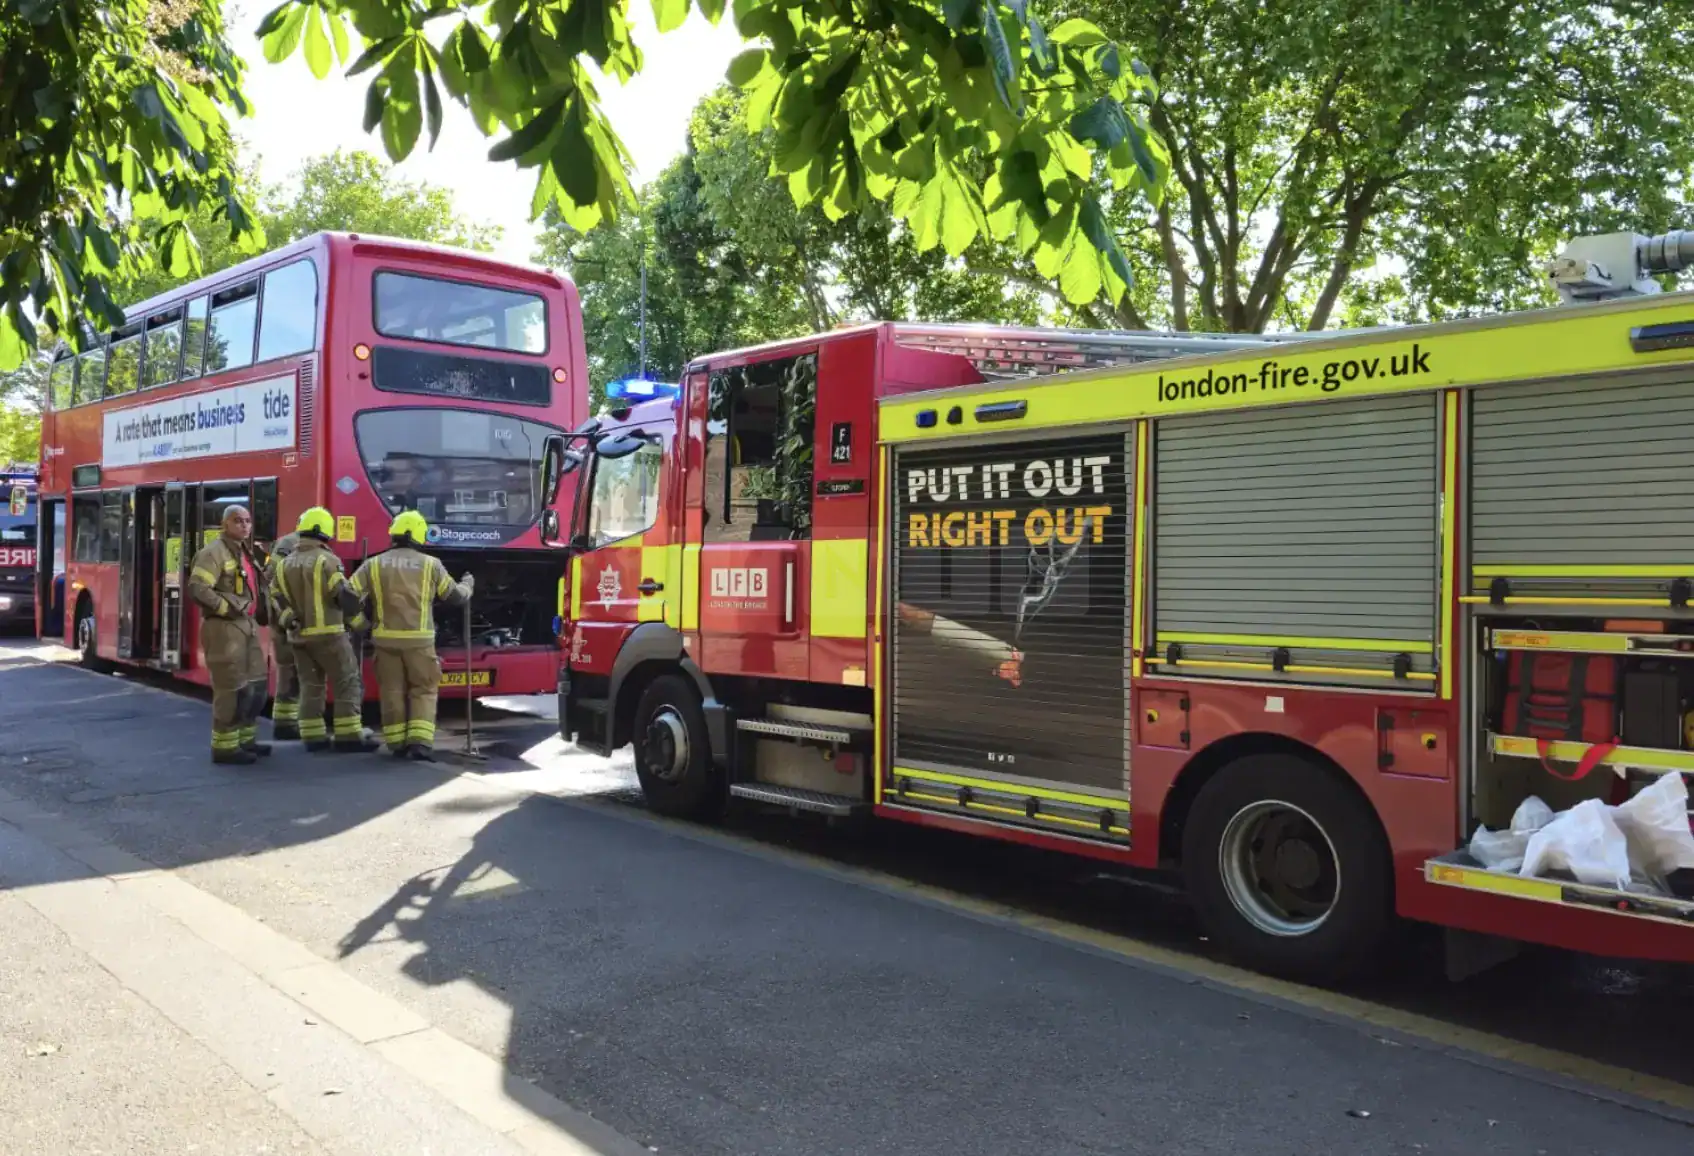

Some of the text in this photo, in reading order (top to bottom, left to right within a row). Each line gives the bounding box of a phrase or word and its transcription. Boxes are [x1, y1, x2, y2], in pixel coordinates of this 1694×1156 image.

[1158, 344, 1431, 402] london-fire.gov.uk
[263, 387, 290, 419] tide
[115, 399, 245, 443] A rate that means business
[839, 427, 846, 442] F
[834, 445, 850, 460] 421
[908, 456, 1111, 503] PUT IT OUT
[442, 528, 501, 541] Stagecoach
[909, 506, 1112, 547] RIGHT OUT
[380, 556, 419, 569] FIRE
[713, 570, 765, 594] LFB
